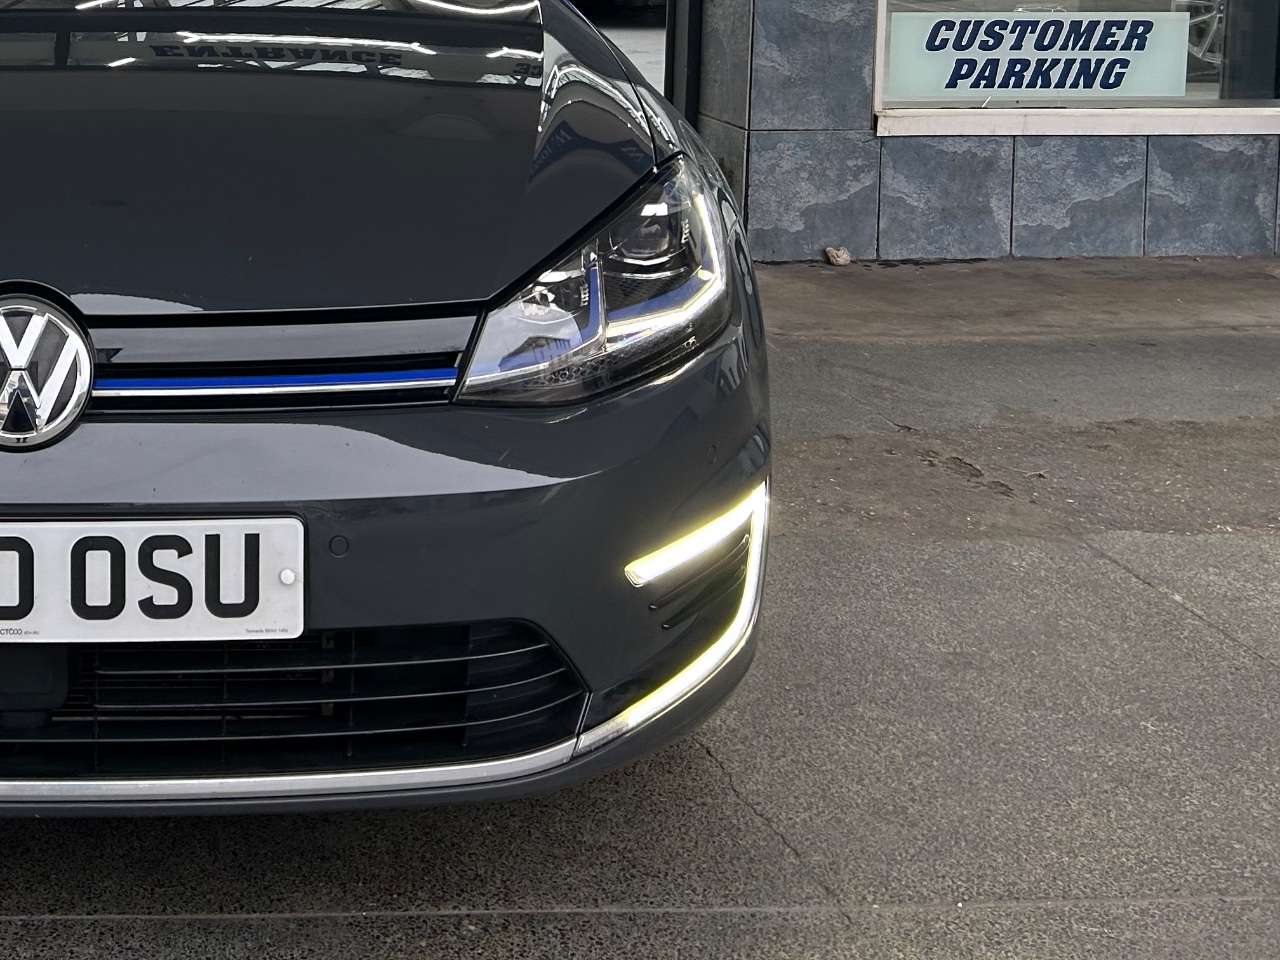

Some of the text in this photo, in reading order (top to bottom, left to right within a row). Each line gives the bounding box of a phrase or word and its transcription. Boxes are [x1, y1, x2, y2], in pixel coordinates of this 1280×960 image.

[925, 19, 1155, 52] CUSTOMER
[944, 57, 1131, 90] PARKING
[70, 532, 261, 620] OSU
